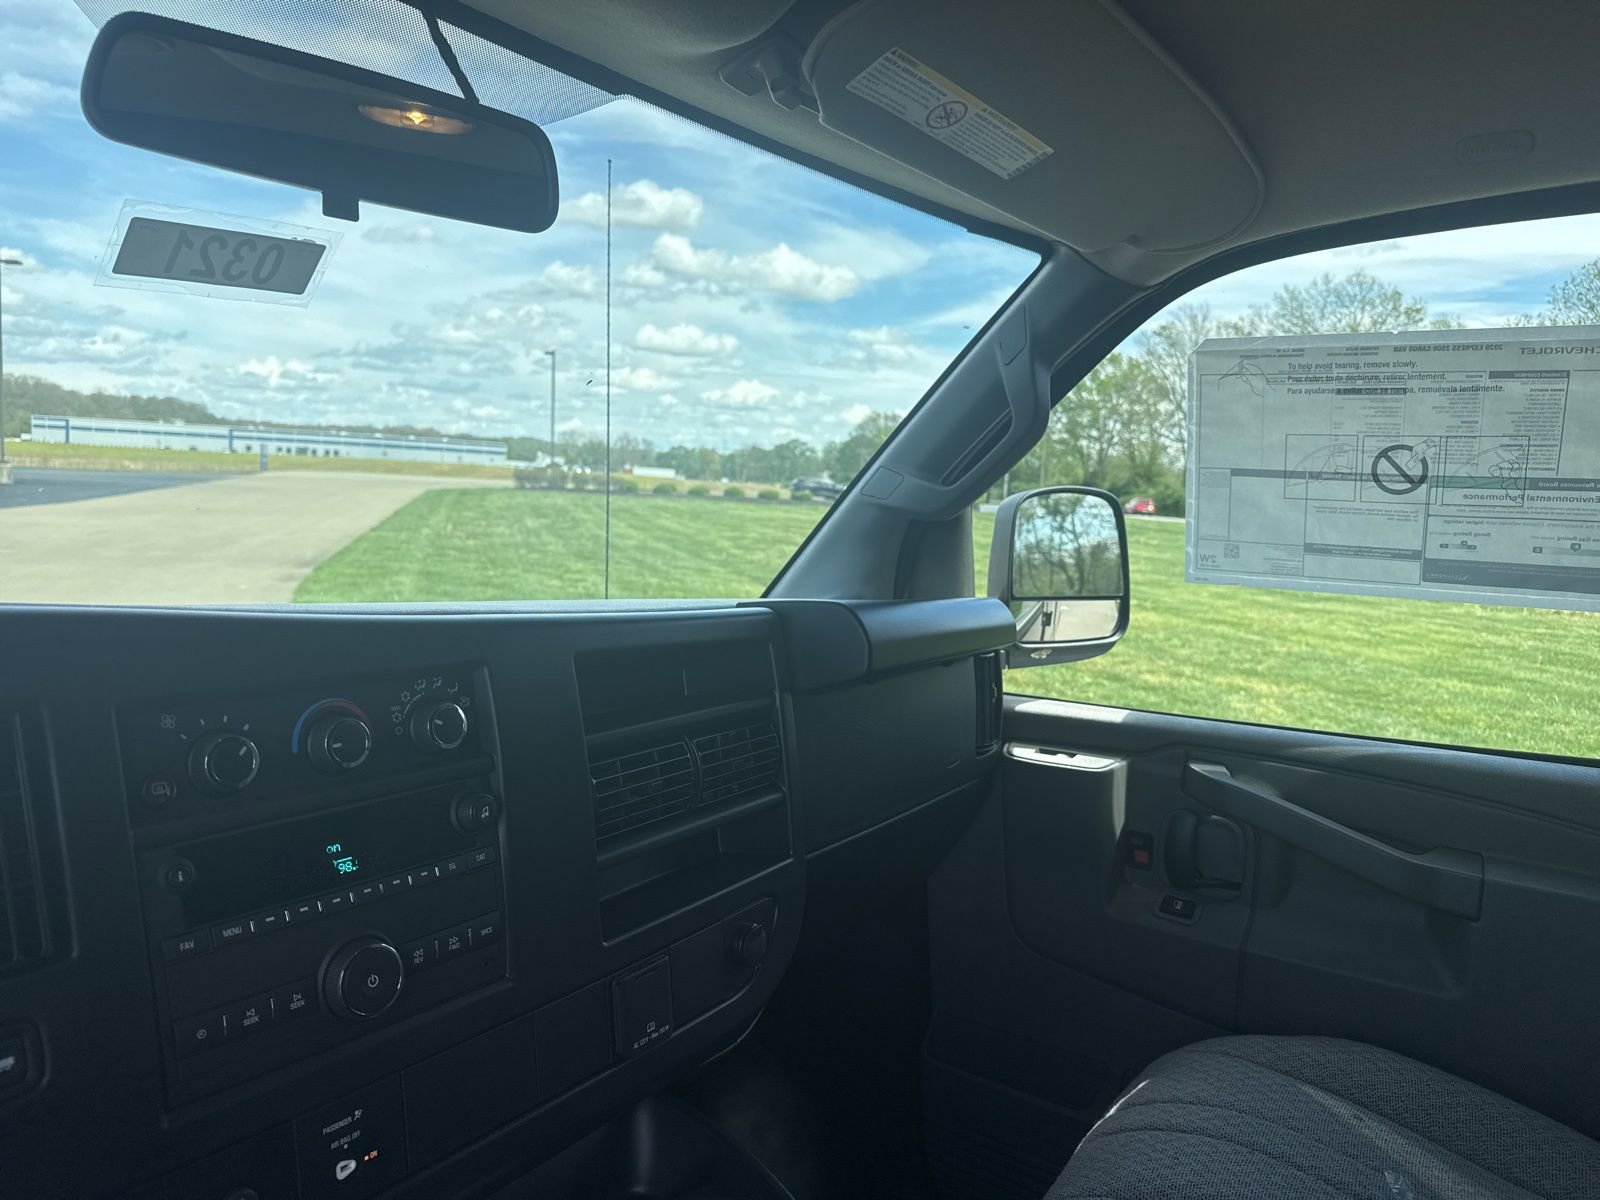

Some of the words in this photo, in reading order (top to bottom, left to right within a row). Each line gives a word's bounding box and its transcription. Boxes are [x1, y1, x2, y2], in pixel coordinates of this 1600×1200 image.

[1298, 362, 1313, 370] help
[1334, 361, 1362, 371] tearing,
[1392, 360, 1418, 369] slowly.
[1407, 373, 1447, 381] lentement.
[1301, 388, 1335, 396] ayudarse
[222, 925, 243, 938] MENU
[179, 939, 195, 952] FAV
[289, 999, 306, 1010] SEEK
[242, 1014, 260, 1027] SEEK
[322, 1115, 353, 1135] PASSENGER
[331, 1140, 340, 1150] AIR
[340, 1134, 351, 1146] BAG
[351, 1129, 361, 1140] OFF
